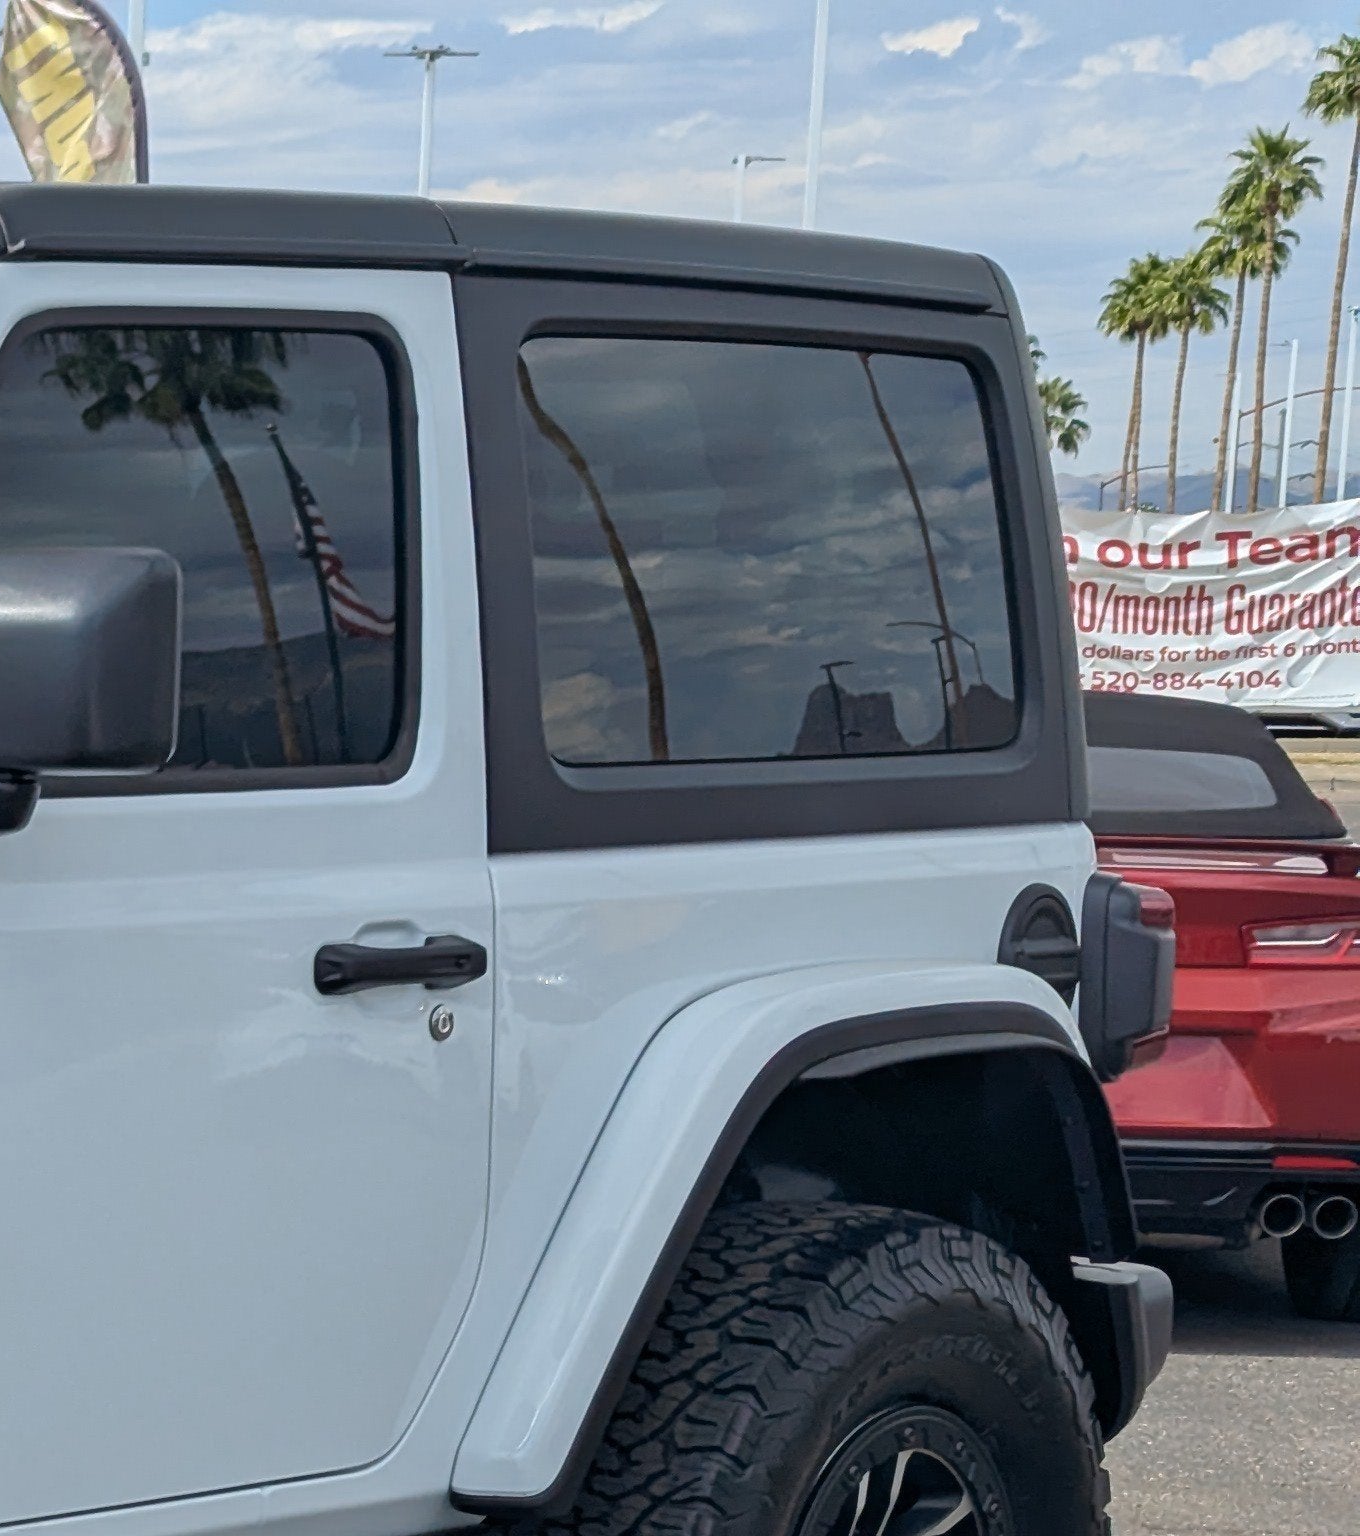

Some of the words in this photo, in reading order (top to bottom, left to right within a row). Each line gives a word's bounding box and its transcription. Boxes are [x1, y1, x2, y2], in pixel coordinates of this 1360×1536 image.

[1097, 539, 1201, 570] our
[1082, 645, 1155, 662] dollars
[1159, 646, 1190, 662] for
[1195, 646, 1231, 662] the
[1235, 642, 1279, 660] first
[1283, 642, 1296, 658] 6
[1091, 669, 1282, 693] 520-884-4104
